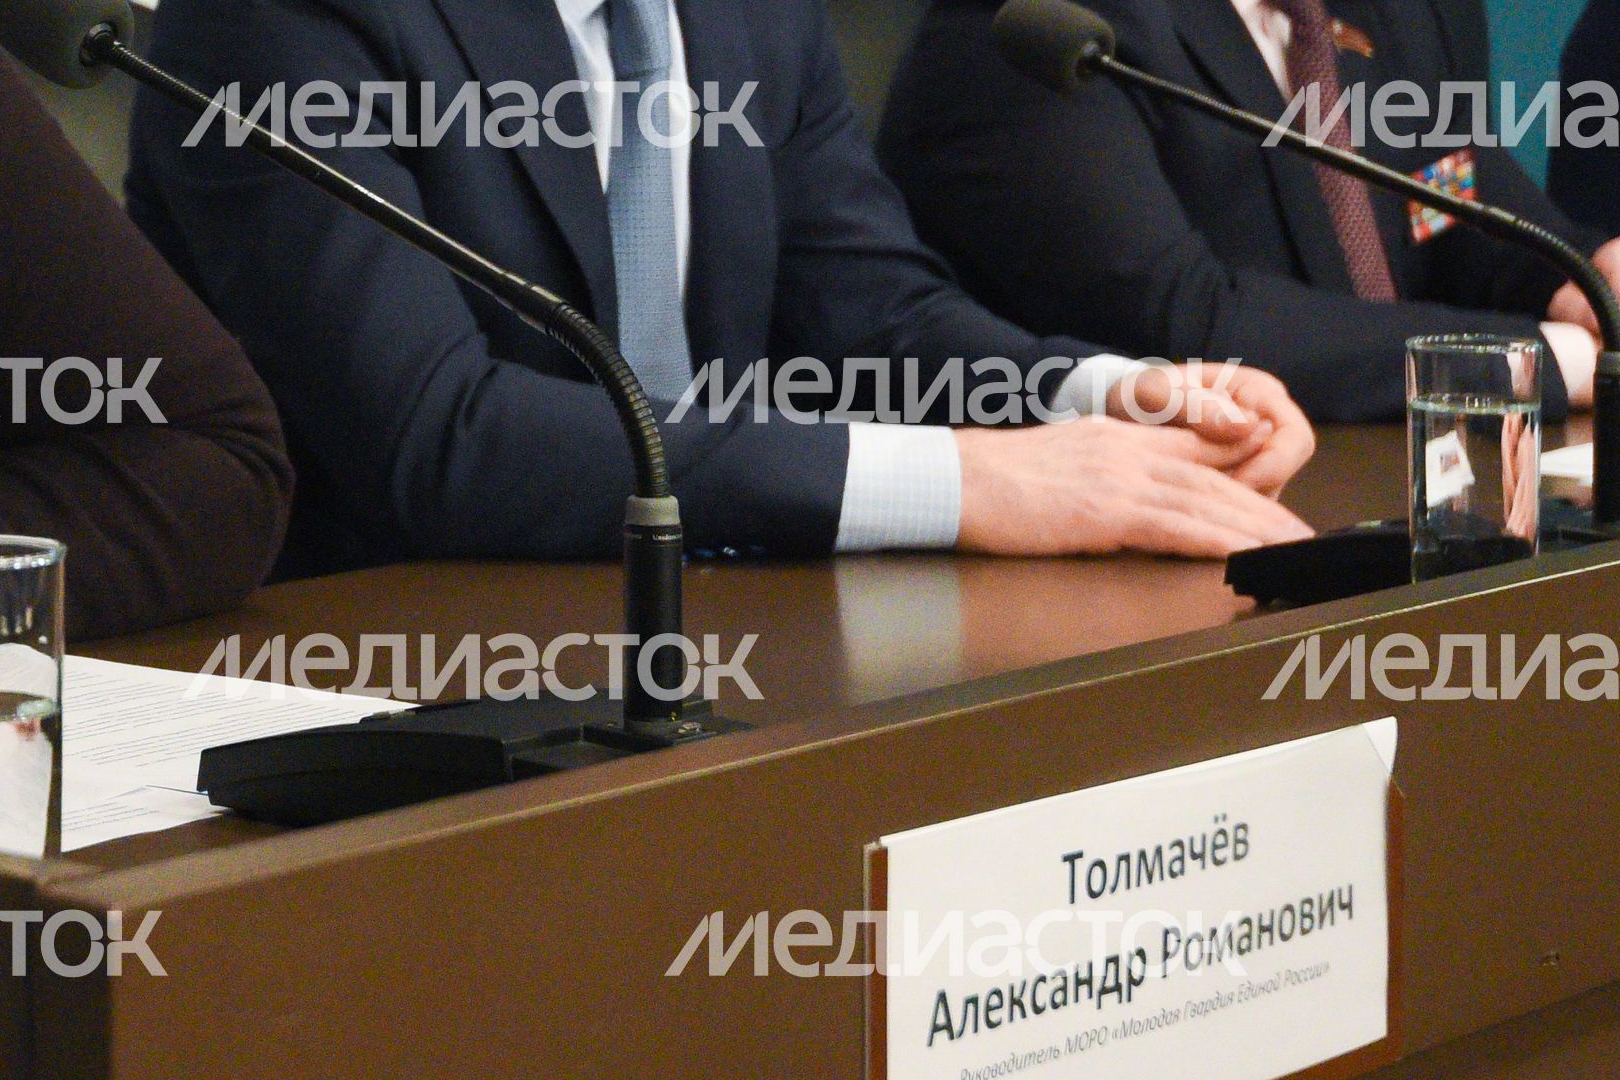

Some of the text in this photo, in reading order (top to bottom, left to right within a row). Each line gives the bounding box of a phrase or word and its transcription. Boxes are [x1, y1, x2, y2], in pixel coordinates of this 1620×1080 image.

[1061, 813, 1251, 904] Толмачёв
[926, 883, 1355, 1048] Александр Романович
[960, 1044, 1060, 1080] Руководитель
